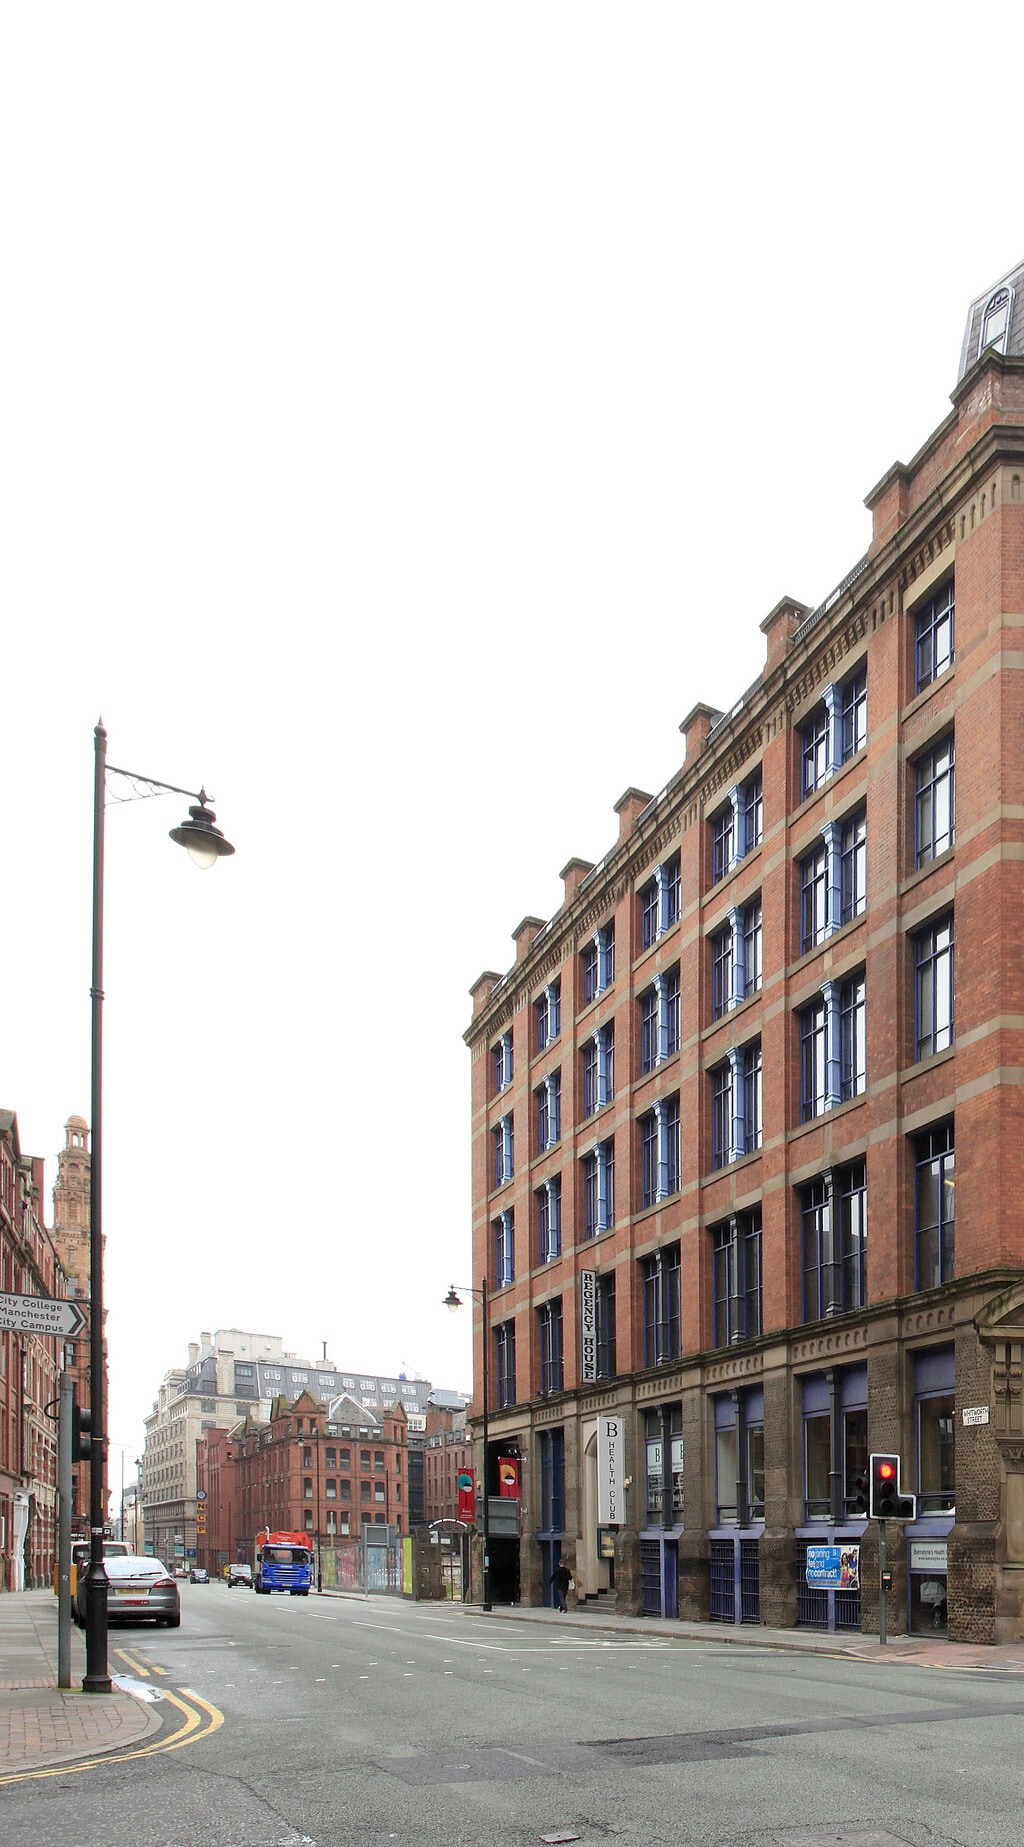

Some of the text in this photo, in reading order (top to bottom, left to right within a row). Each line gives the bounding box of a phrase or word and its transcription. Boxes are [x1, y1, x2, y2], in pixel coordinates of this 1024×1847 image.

[22, 1300, 62, 1312] College
[0, 1307, 61, 1321] Manchester
[21, 1320, 64, 1332] Campus
[583, 1273, 594, 1380] REGENCY HOUSE
[967, 1416, 982, 1424] STREET
[606, 1422, 618, 1437] B
